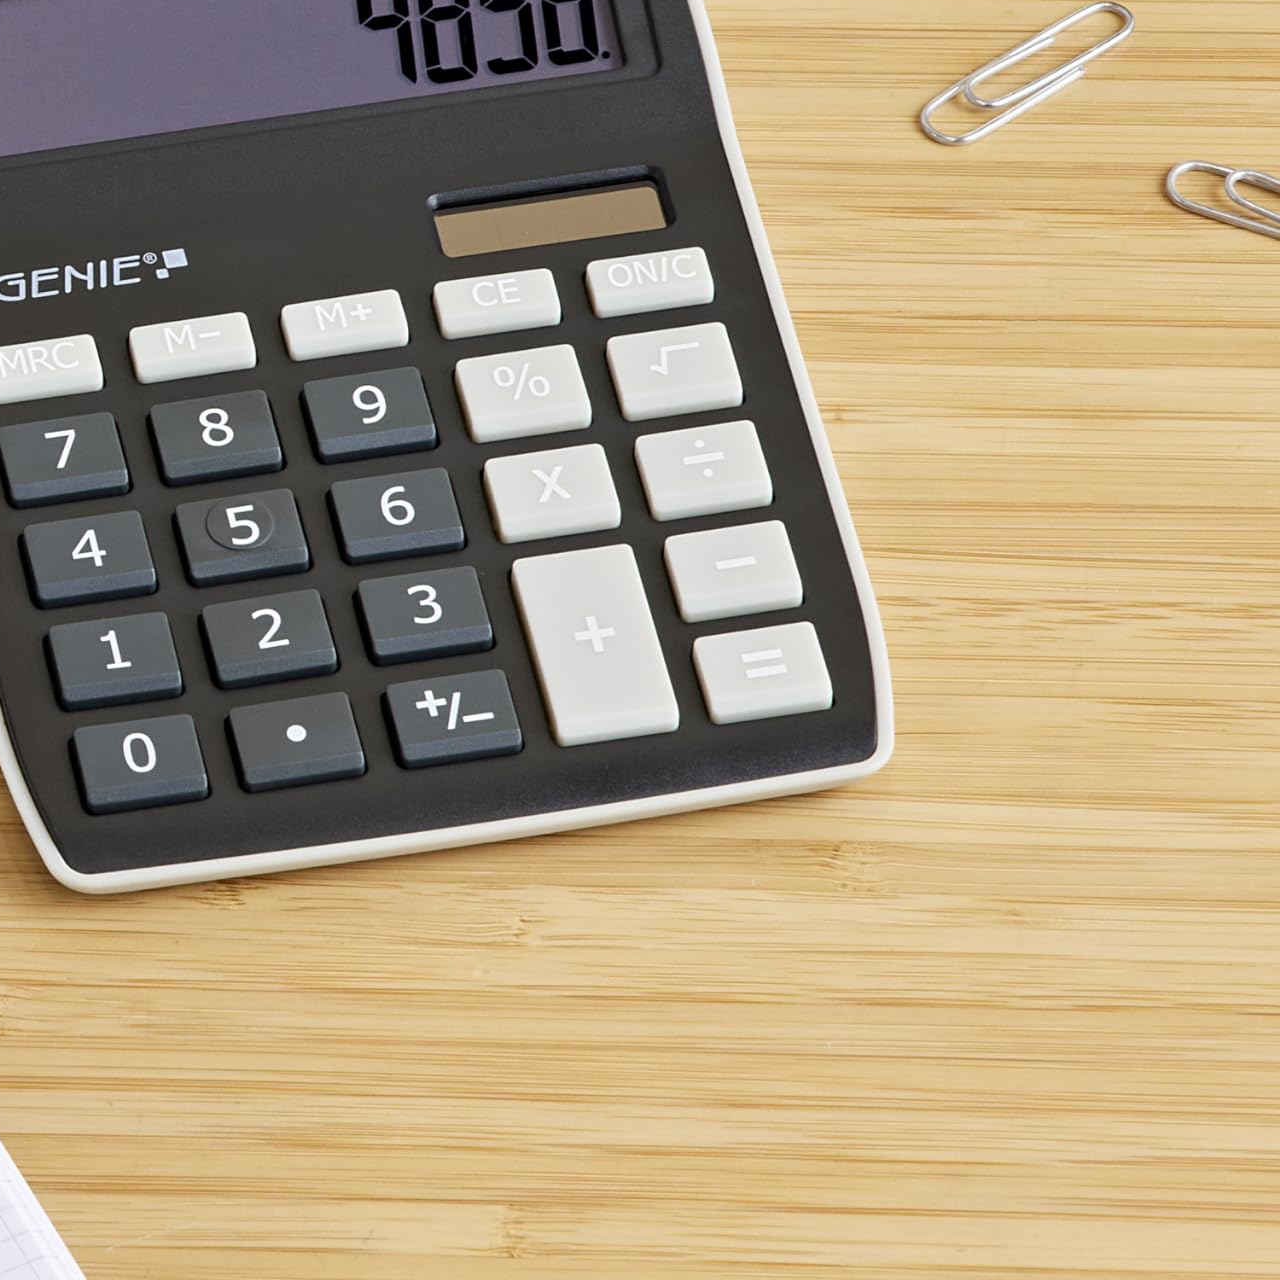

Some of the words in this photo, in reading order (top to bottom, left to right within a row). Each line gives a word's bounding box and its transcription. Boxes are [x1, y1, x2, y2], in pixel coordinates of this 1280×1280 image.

[606, 254, 698, 289] ON/C
[472, 277, 521, 308] CE
[312, 300, 373, 332] M+
[492, 362, 551, 401] %
[352, 384, 387, 425] 9
[198, 407, 235, 447] 8
[44, 428, 76, 469] 7
[225, 504, 260, 546] 5
[380, 485, 416, 526] 6
[71, 528, 107, 568] 4
[407, 584, 443, 625] 3
[99, 629, 132, 670] 1
[251, 608, 290, 650] 2
[122, 732, 157, 773] 0
